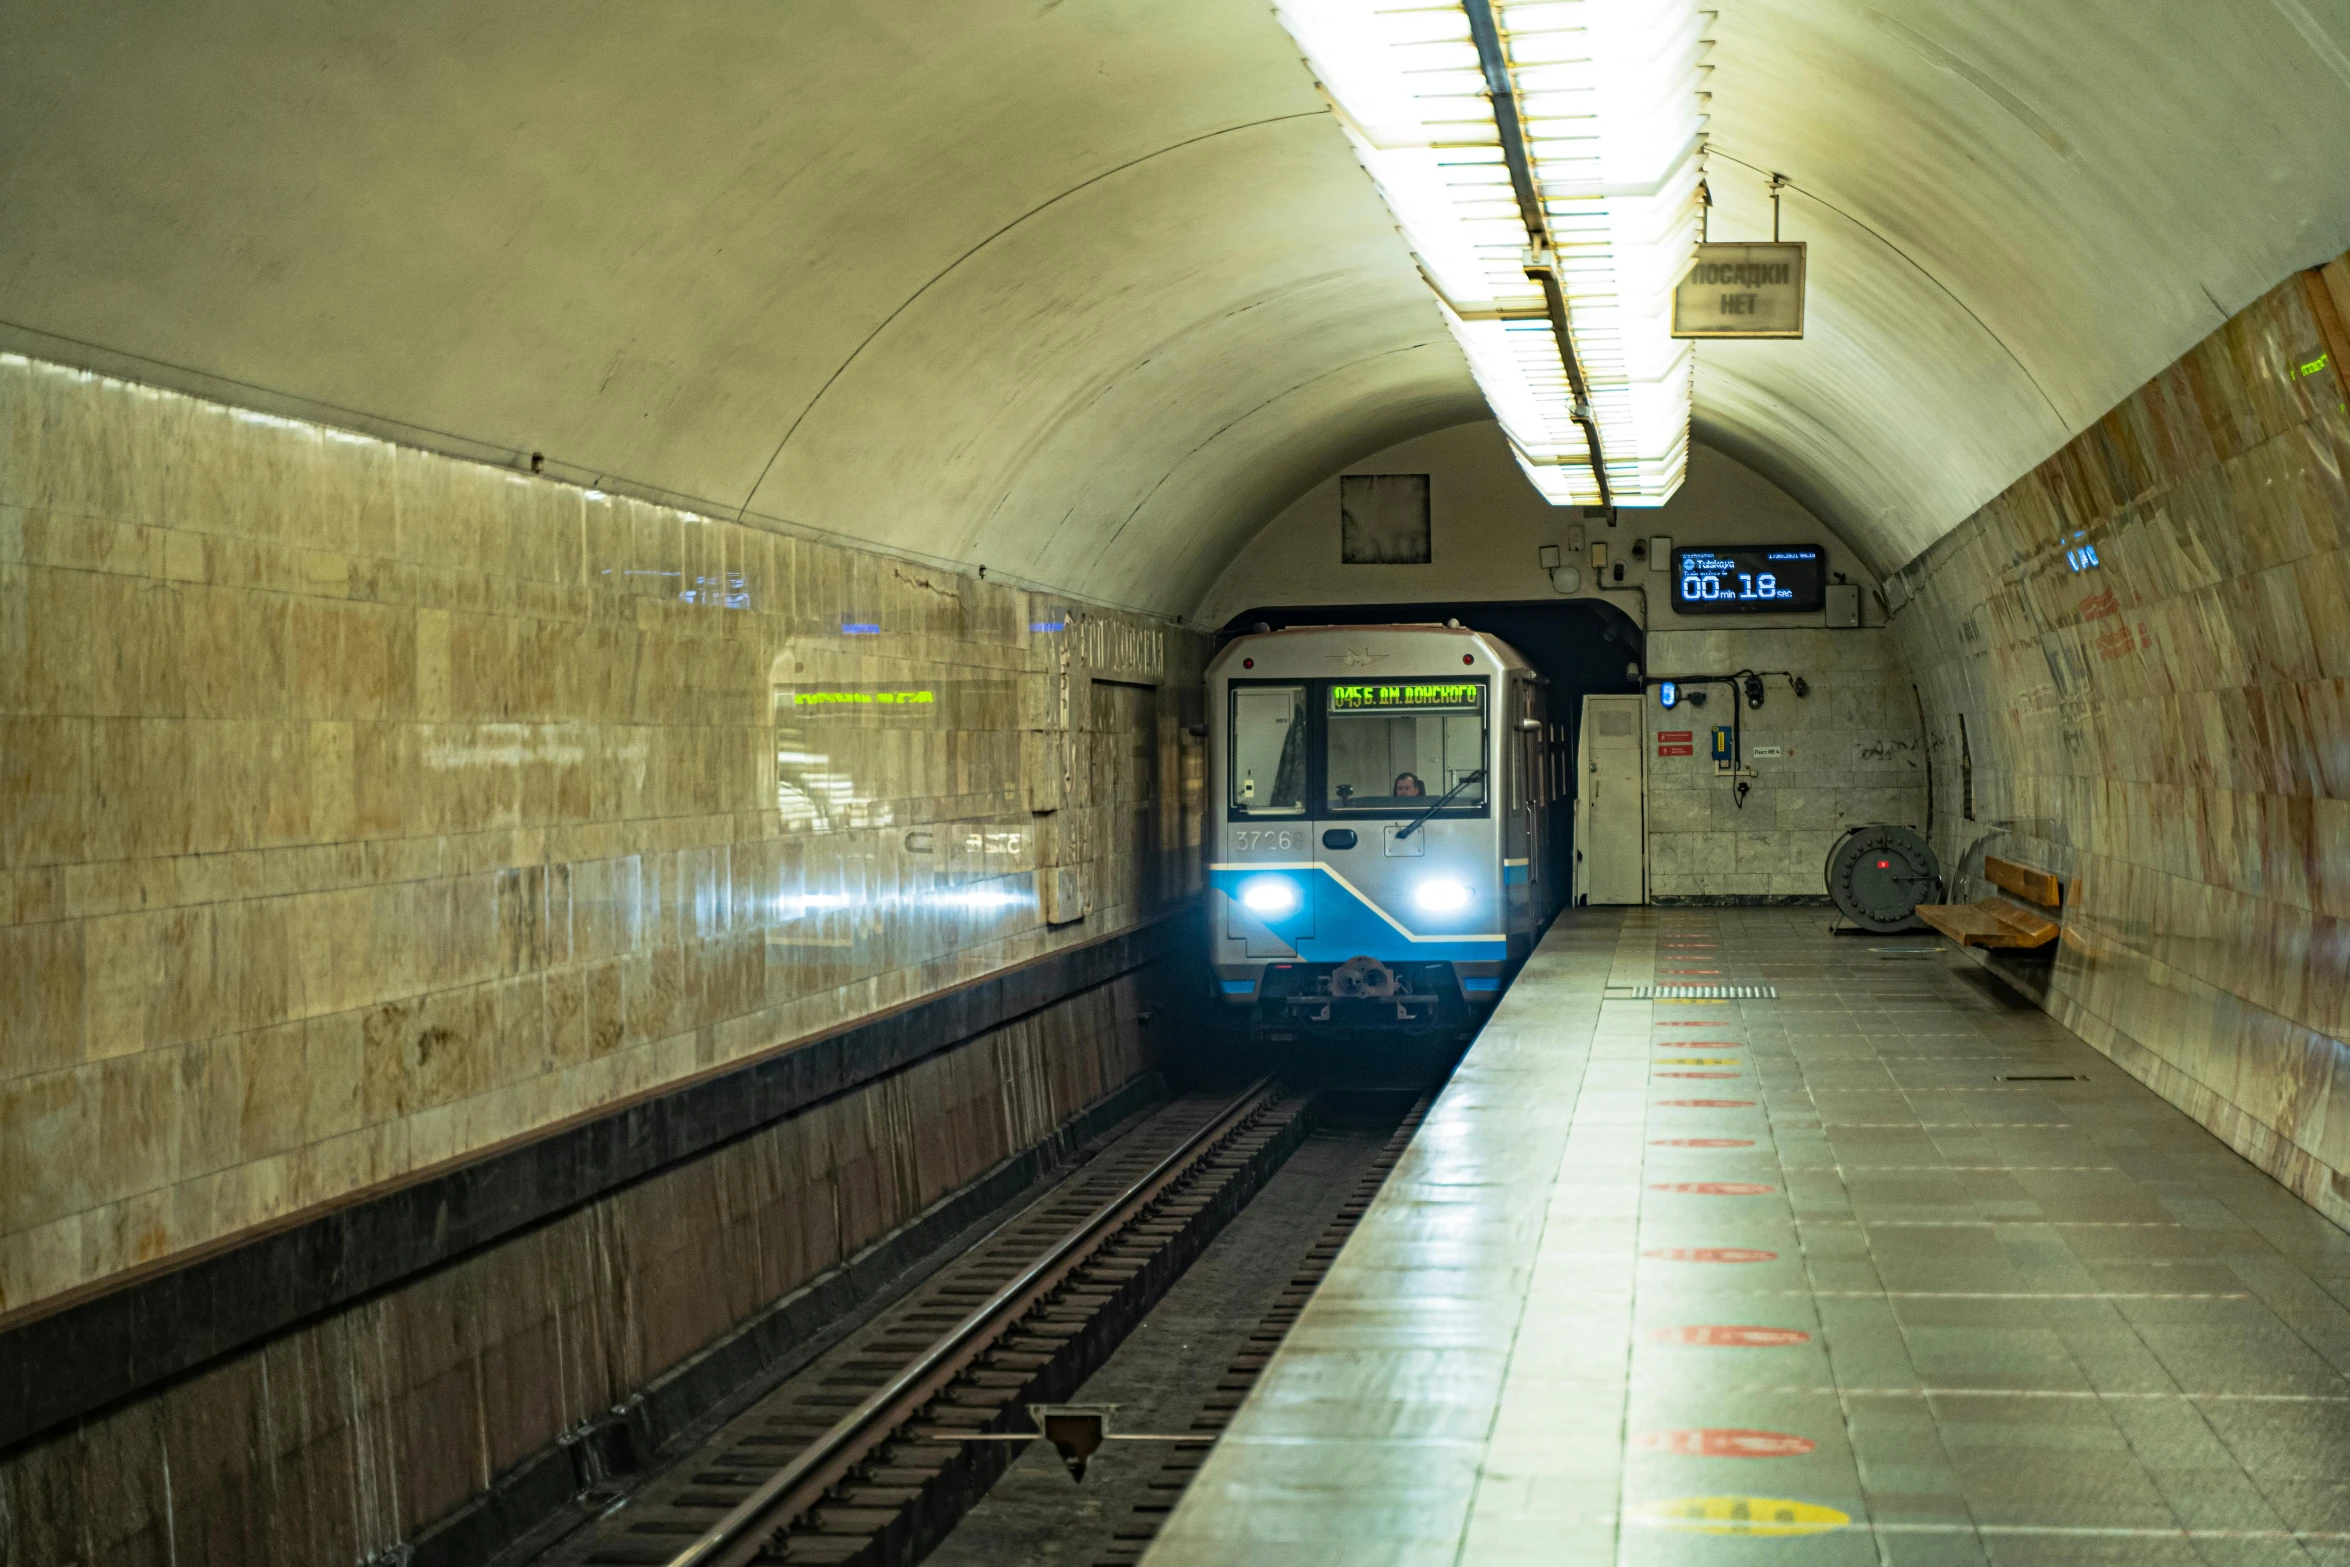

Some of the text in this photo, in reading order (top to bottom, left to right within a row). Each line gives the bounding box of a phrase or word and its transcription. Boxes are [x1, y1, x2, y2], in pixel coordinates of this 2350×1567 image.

[1691, 263, 1789, 288] ПОСАДКИ
[1720, 293, 1758, 315] НЕТ
[1697, 559, 1735, 569] Tulskaya
[1683, 574, 1792, 599] 00 min 18 sec
[1236, 830, 1292, 851] 3726
